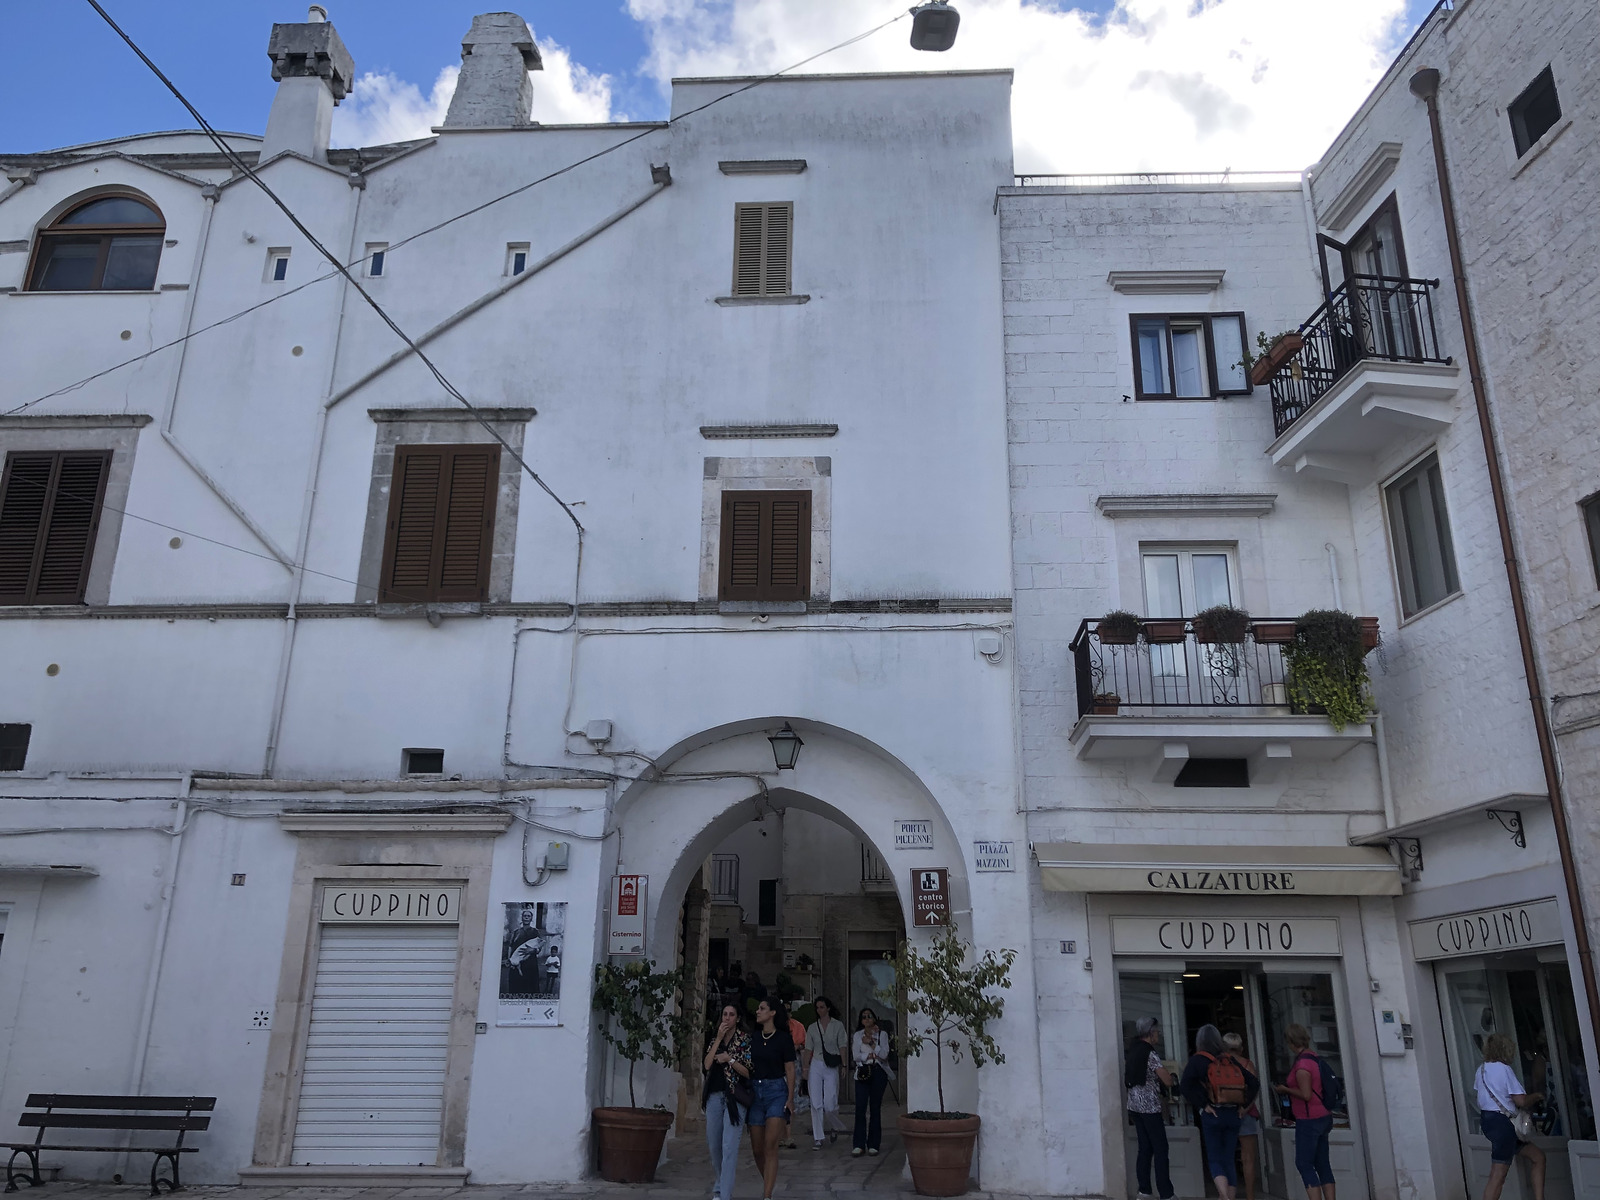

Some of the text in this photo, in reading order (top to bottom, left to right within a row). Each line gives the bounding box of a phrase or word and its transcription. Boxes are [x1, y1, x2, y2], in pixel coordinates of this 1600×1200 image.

[901, 824, 927, 833] PORTA
[979, 844, 1009, 854] PIAZZA
[976, 858, 1009, 868] MAZZINI
[1147, 871, 1295, 890] CALZATURE
[334, 893, 449, 916] CUPPINO
[917, 902, 945, 910] storico
[1158, 922, 1293, 950] CUPPINO
[1437, 909, 1532, 952] CUPPINO
